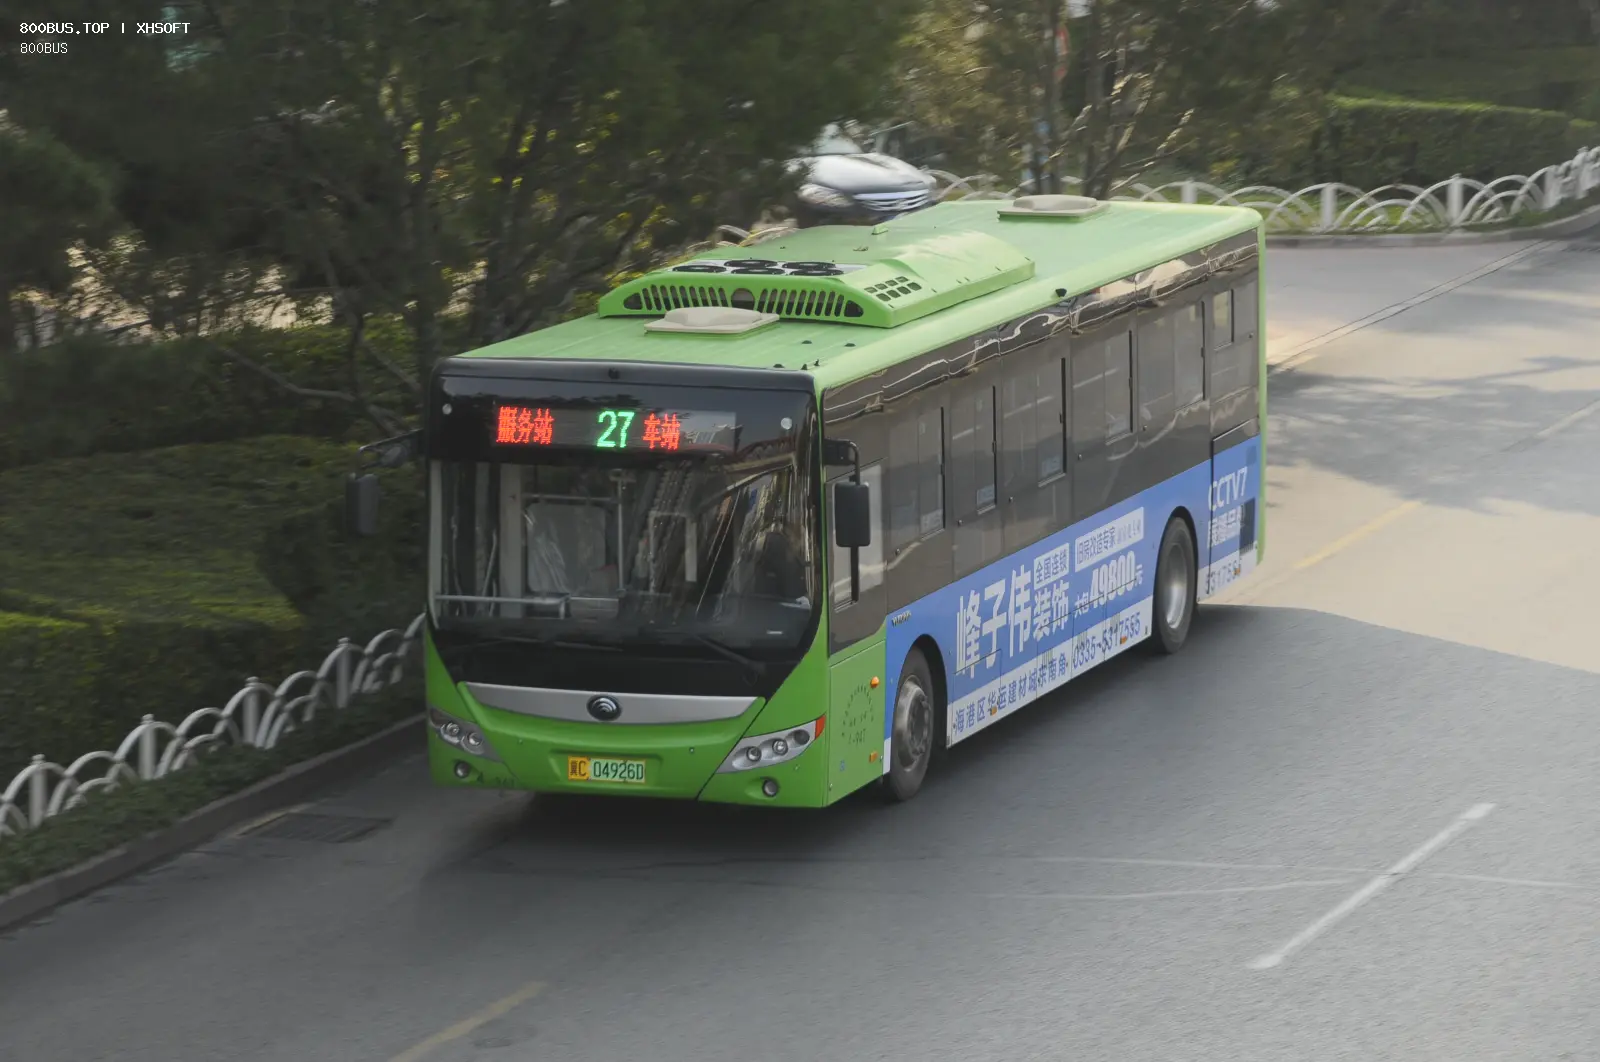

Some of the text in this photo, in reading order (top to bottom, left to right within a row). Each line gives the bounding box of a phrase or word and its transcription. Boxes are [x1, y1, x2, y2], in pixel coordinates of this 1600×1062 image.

[496, 405, 681, 450] 服务站 27 车站
[1208, 466, 1248, 511] CCTV7
[1036, 548, 1067, 584] 全国连锁
[956, 564, 1032, 679] 峰子伟
[1033, 579, 1069, 641] 装饰
[569, 759, 645, 781] 冀C 04926D
